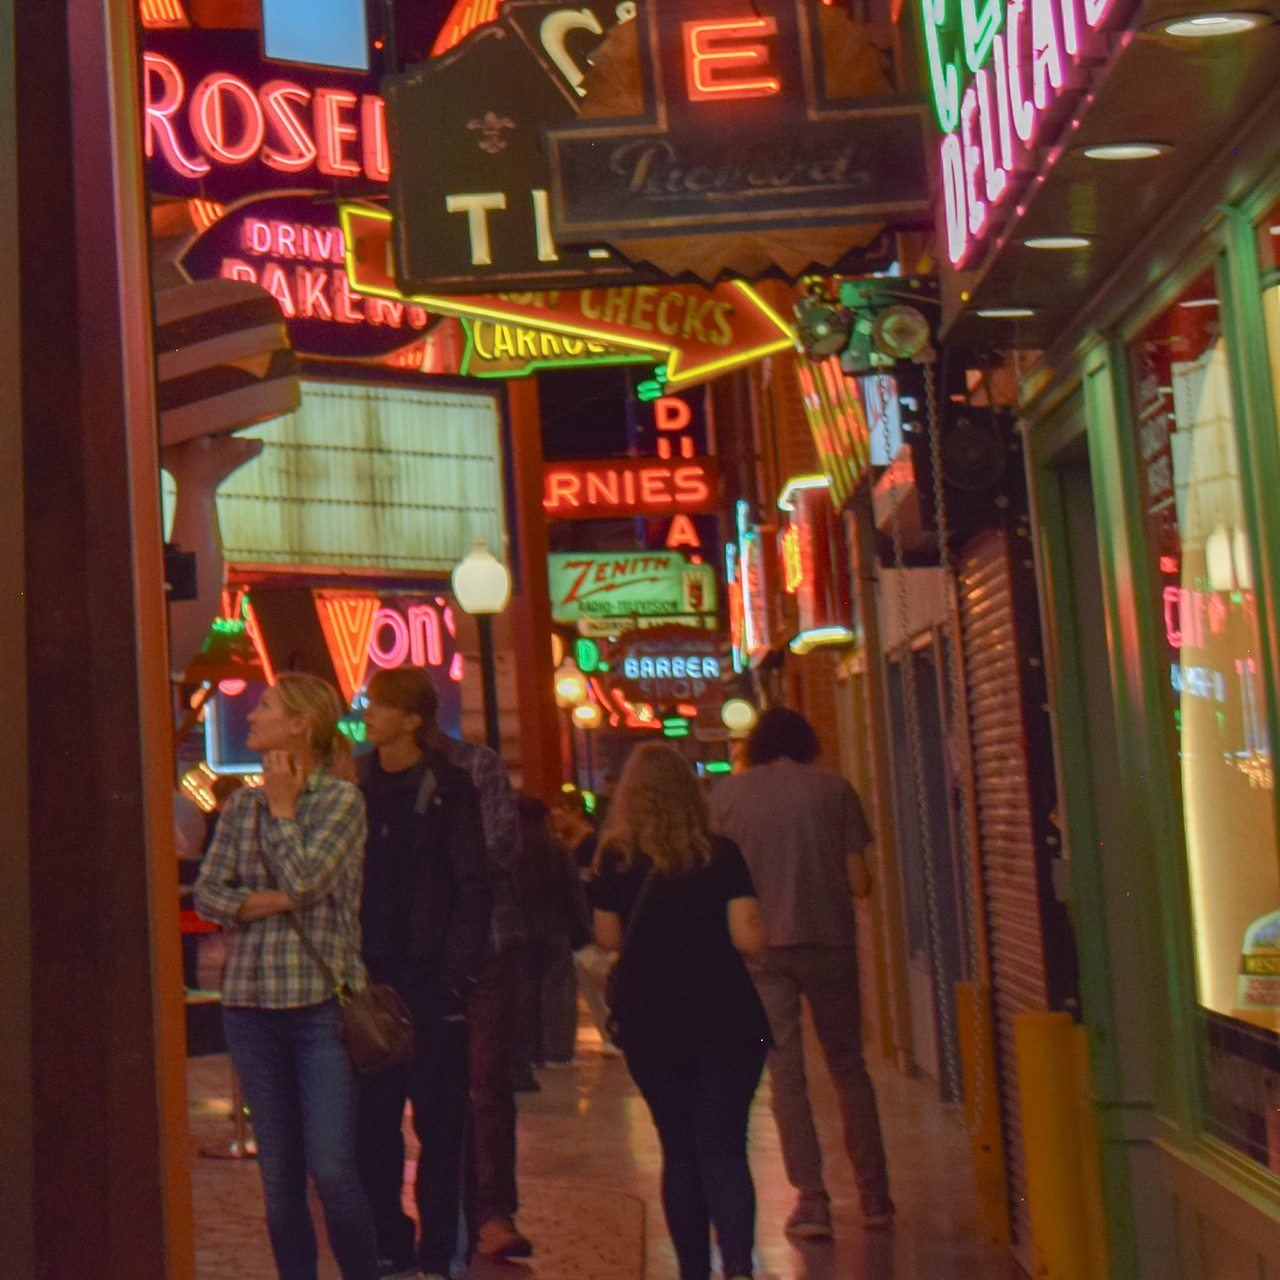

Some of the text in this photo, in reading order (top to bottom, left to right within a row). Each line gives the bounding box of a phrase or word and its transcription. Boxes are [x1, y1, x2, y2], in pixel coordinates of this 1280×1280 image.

[580, 285, 736, 346] CHECKS
[542, 466, 709, 508] RNIES
[561, 556, 672, 604] ZENITH
[623, 656, 721, 679] BARBER
